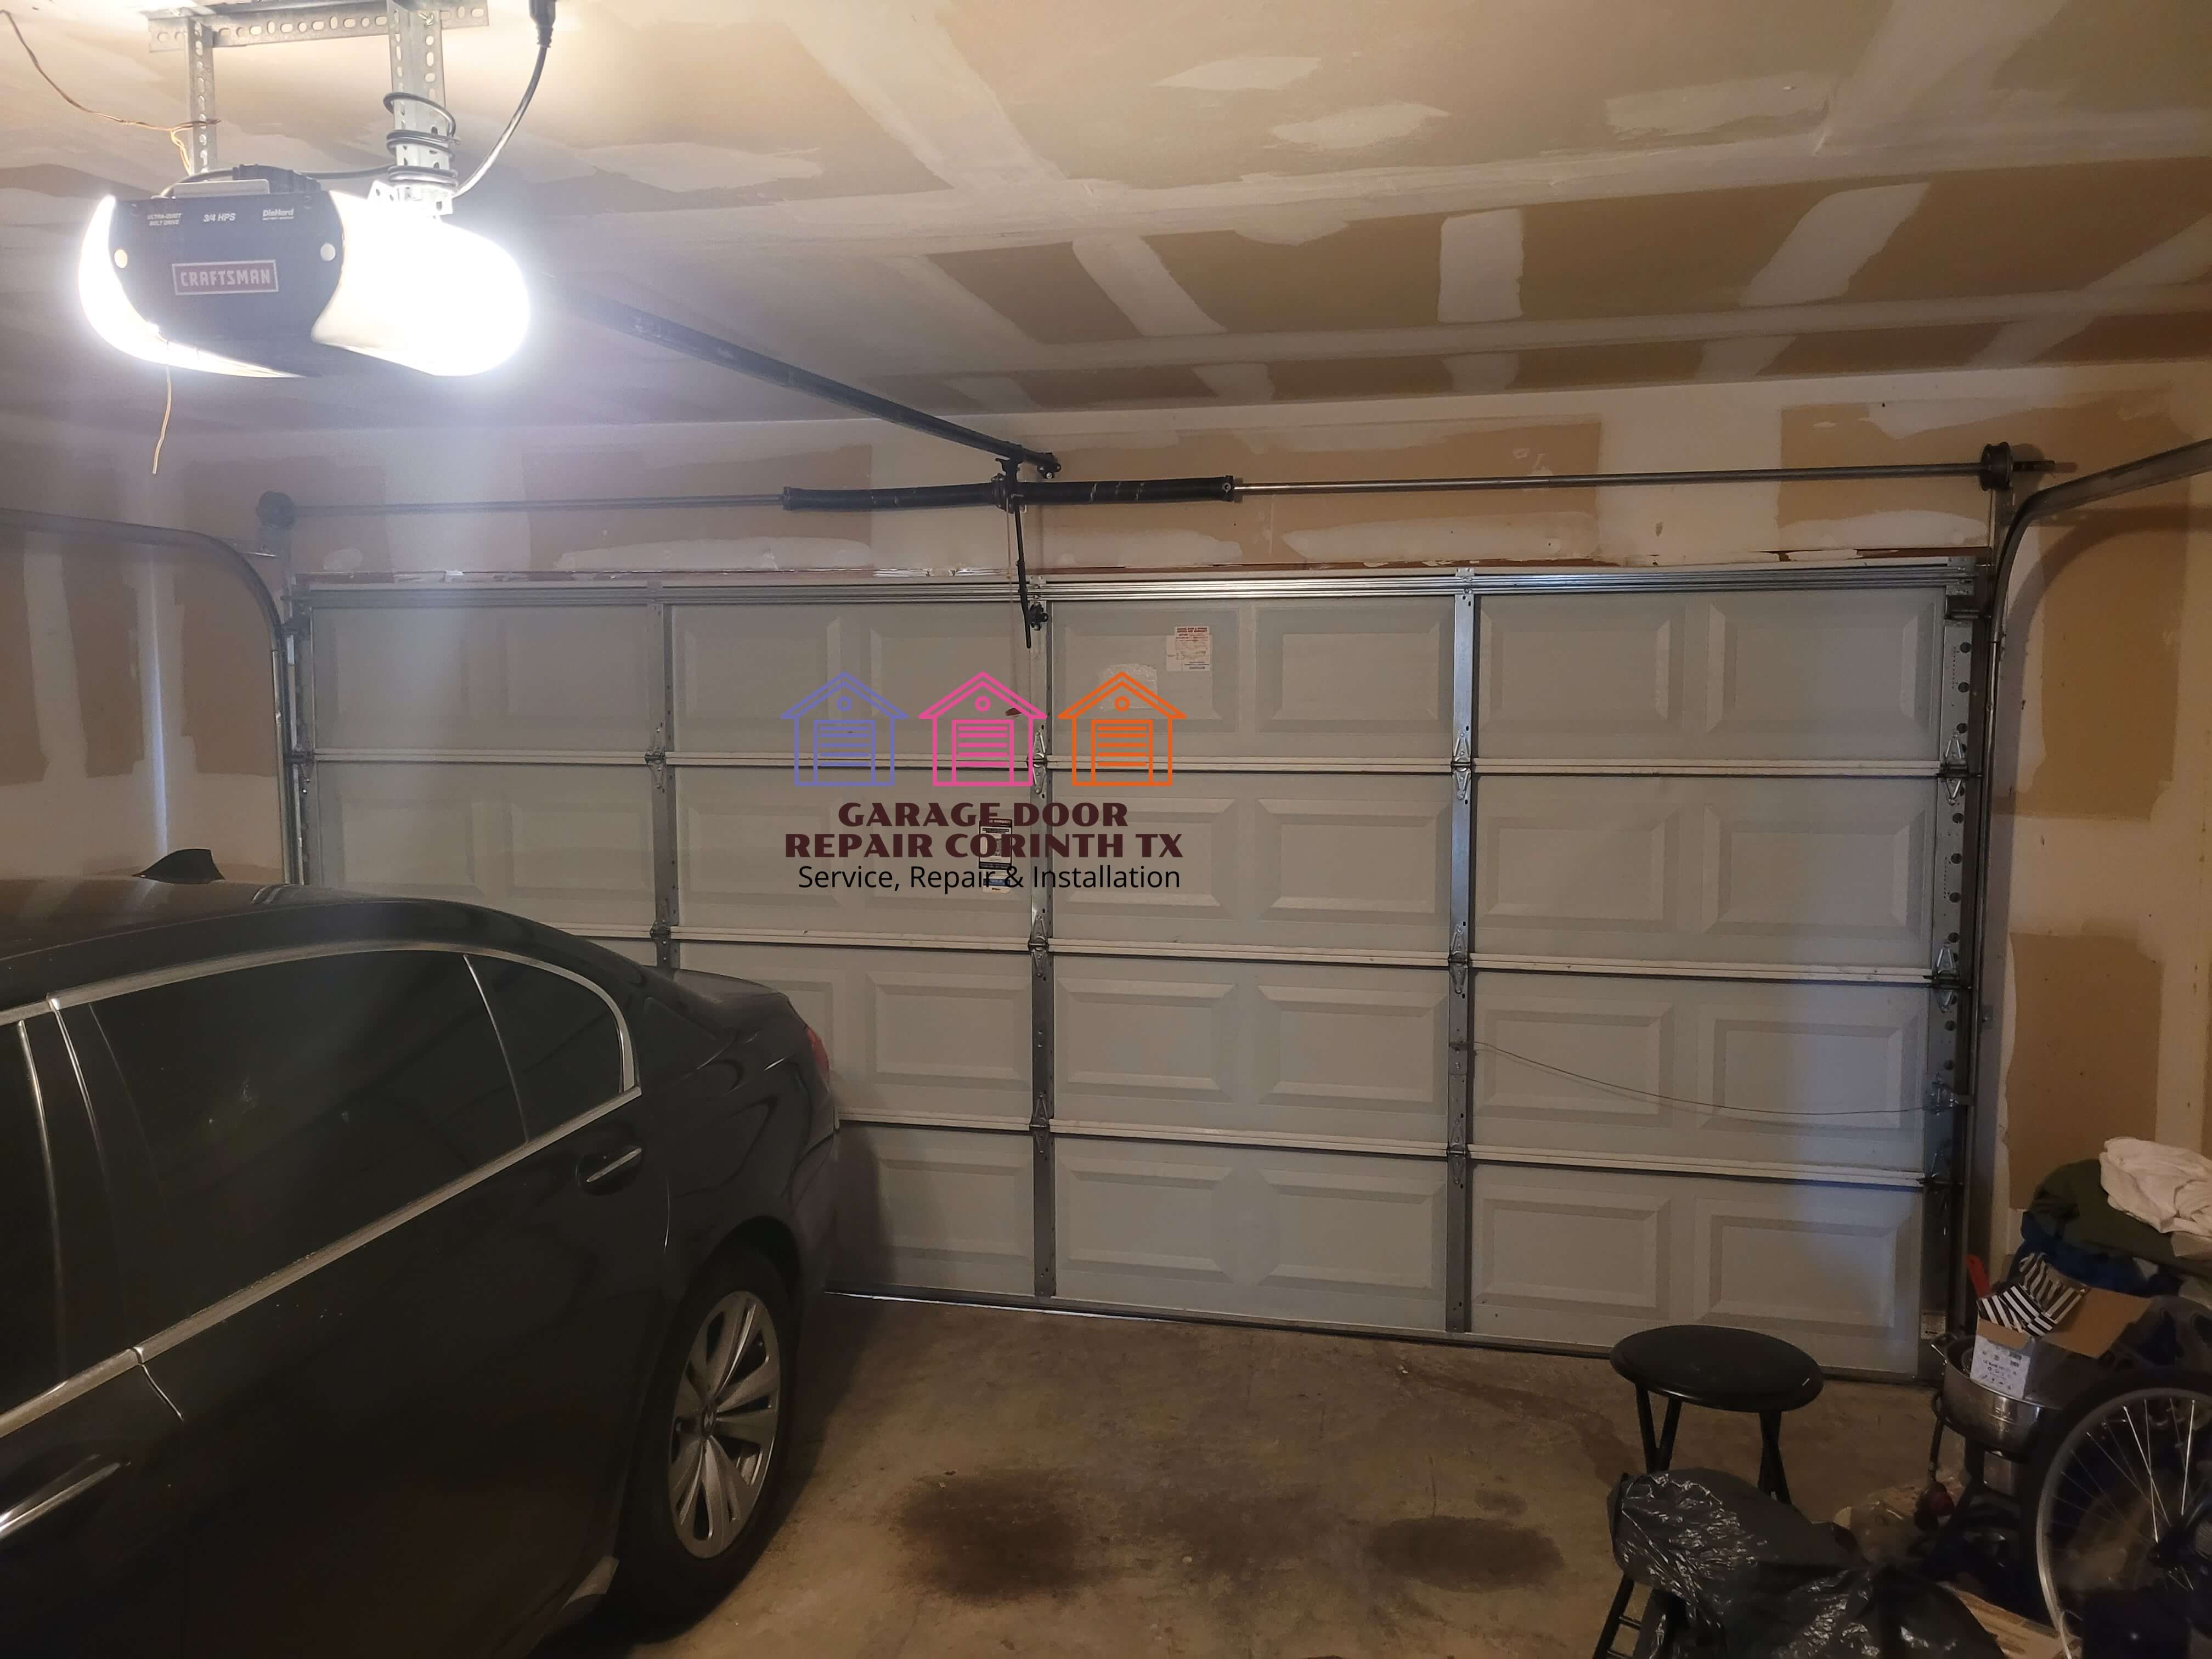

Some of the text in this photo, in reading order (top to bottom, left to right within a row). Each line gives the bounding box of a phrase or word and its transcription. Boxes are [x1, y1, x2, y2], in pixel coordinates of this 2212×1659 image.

[263, 208, 295, 217] DieHard
[202, 213, 236, 222] 3/4 HPS
[180, 269, 270, 287] CRAFTSMAN
